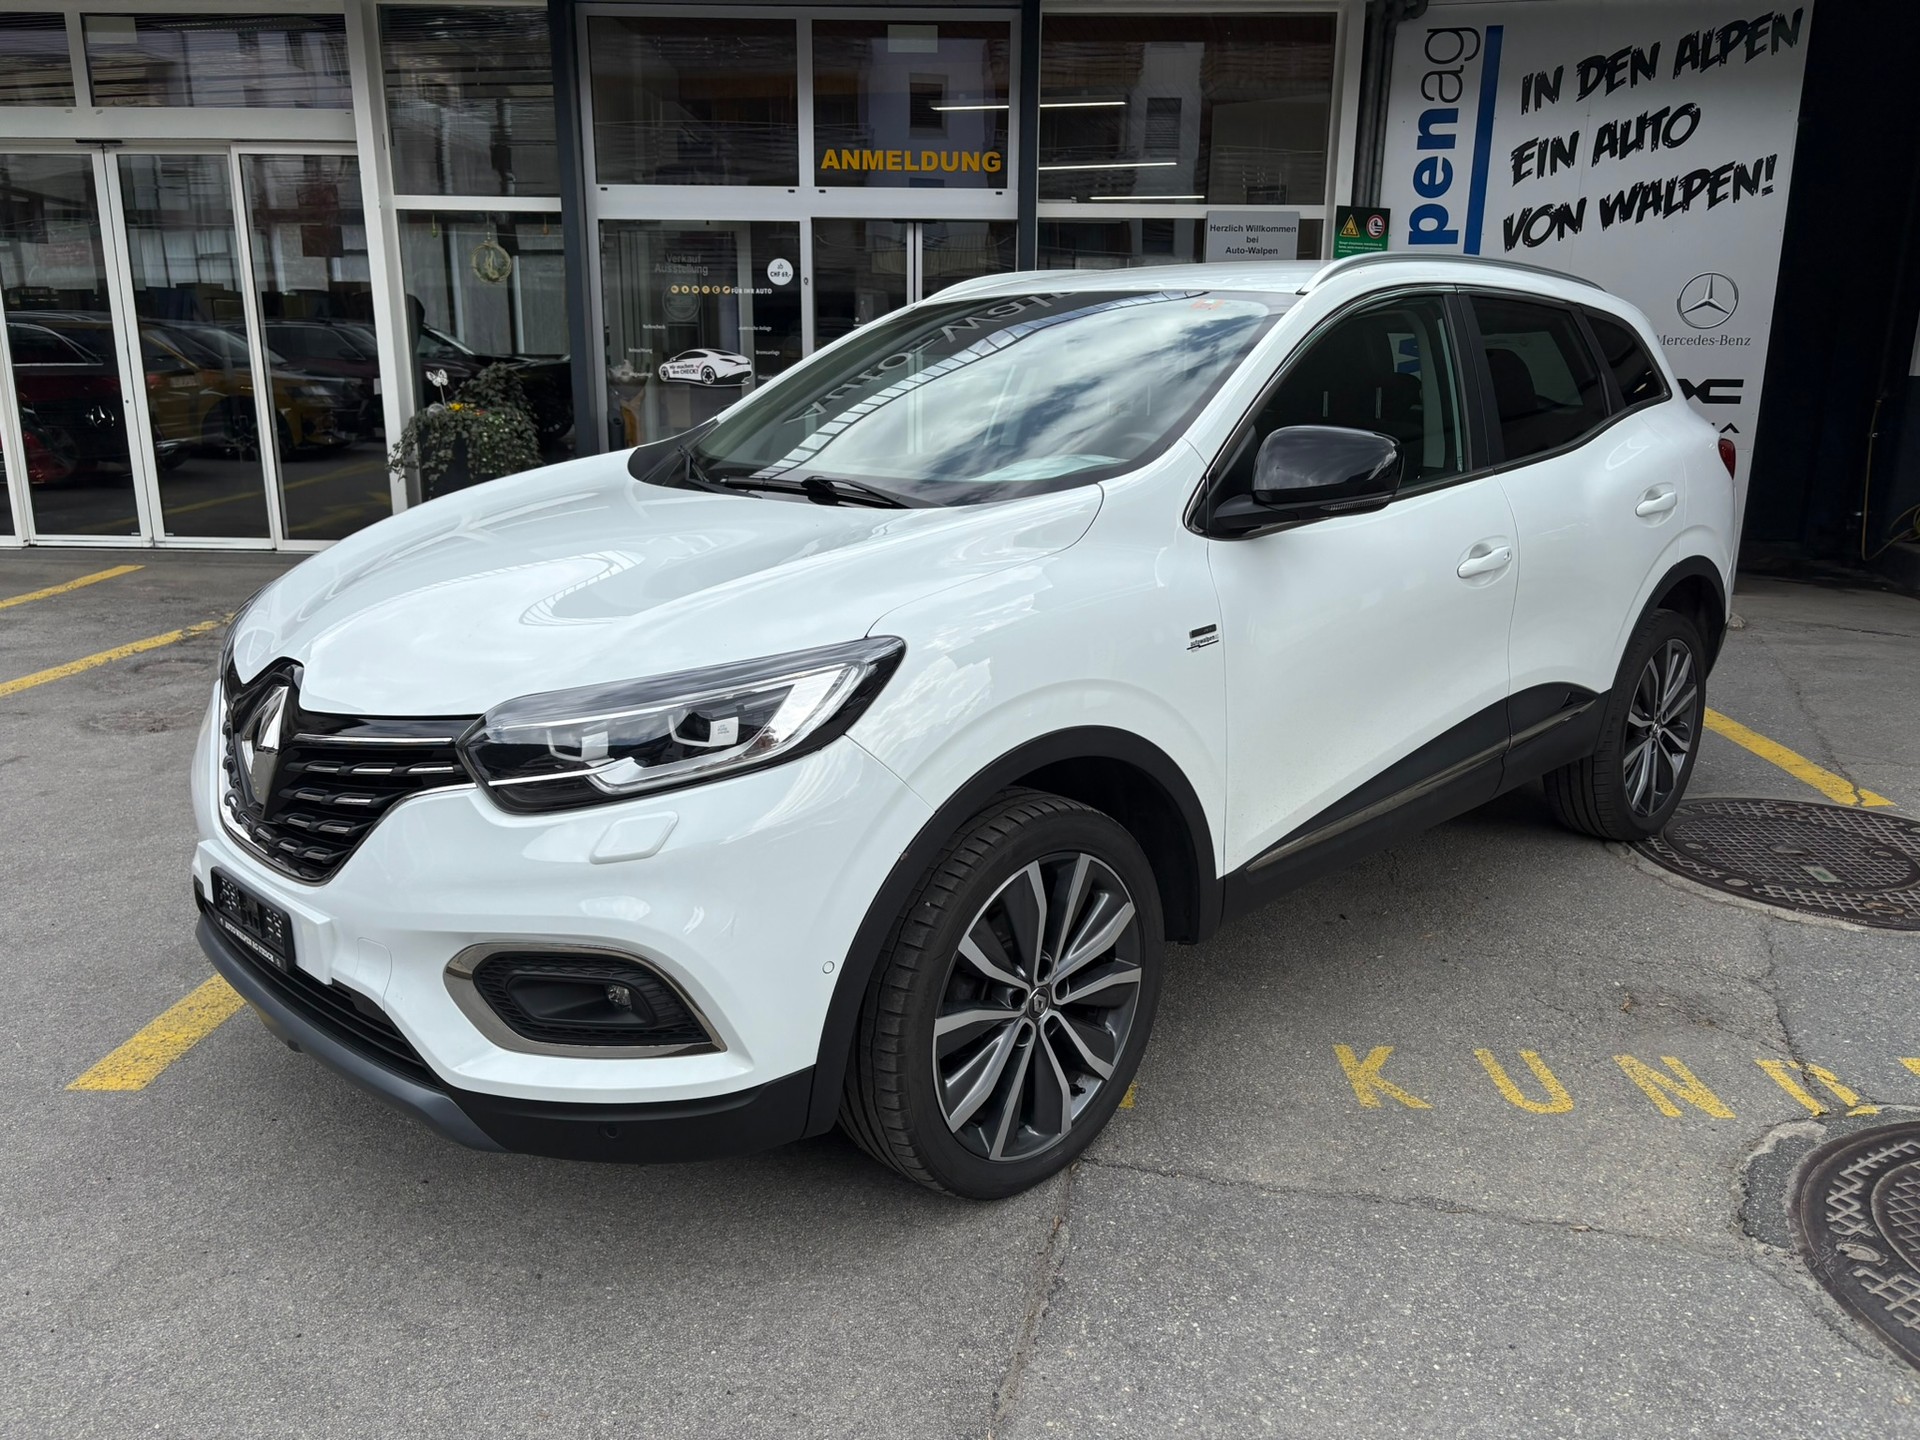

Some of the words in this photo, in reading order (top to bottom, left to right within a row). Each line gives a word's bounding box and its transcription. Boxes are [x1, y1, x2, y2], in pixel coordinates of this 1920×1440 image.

[1520, 65, 1564, 115] IN
[1576, 41, 1661, 102] DEN
[1673, 7, 1804, 80] ALPEN
[1510, 130, 1580, 187] EIN
[1591, 102, 1702, 168] AUTO
[820, 148, 1002, 174] ANMELDUNG
[1502, 197, 1587, 253] VON
[1599, 153, 1778, 232] WALPEN!
[1209, 224, 1244, 233] Herzlich
[1245, 224, 1297, 233] Willkommen
[1246, 235, 1259, 244] bei
[666, 252, 702, 263] Verkauf
[1225, 246, 1279, 256] Auto-Walpen
[654, 263, 709, 276] Ausstellung
[755, 287, 773, 295] AUTO
[1333, 1044, 1920, 1119] KUND
